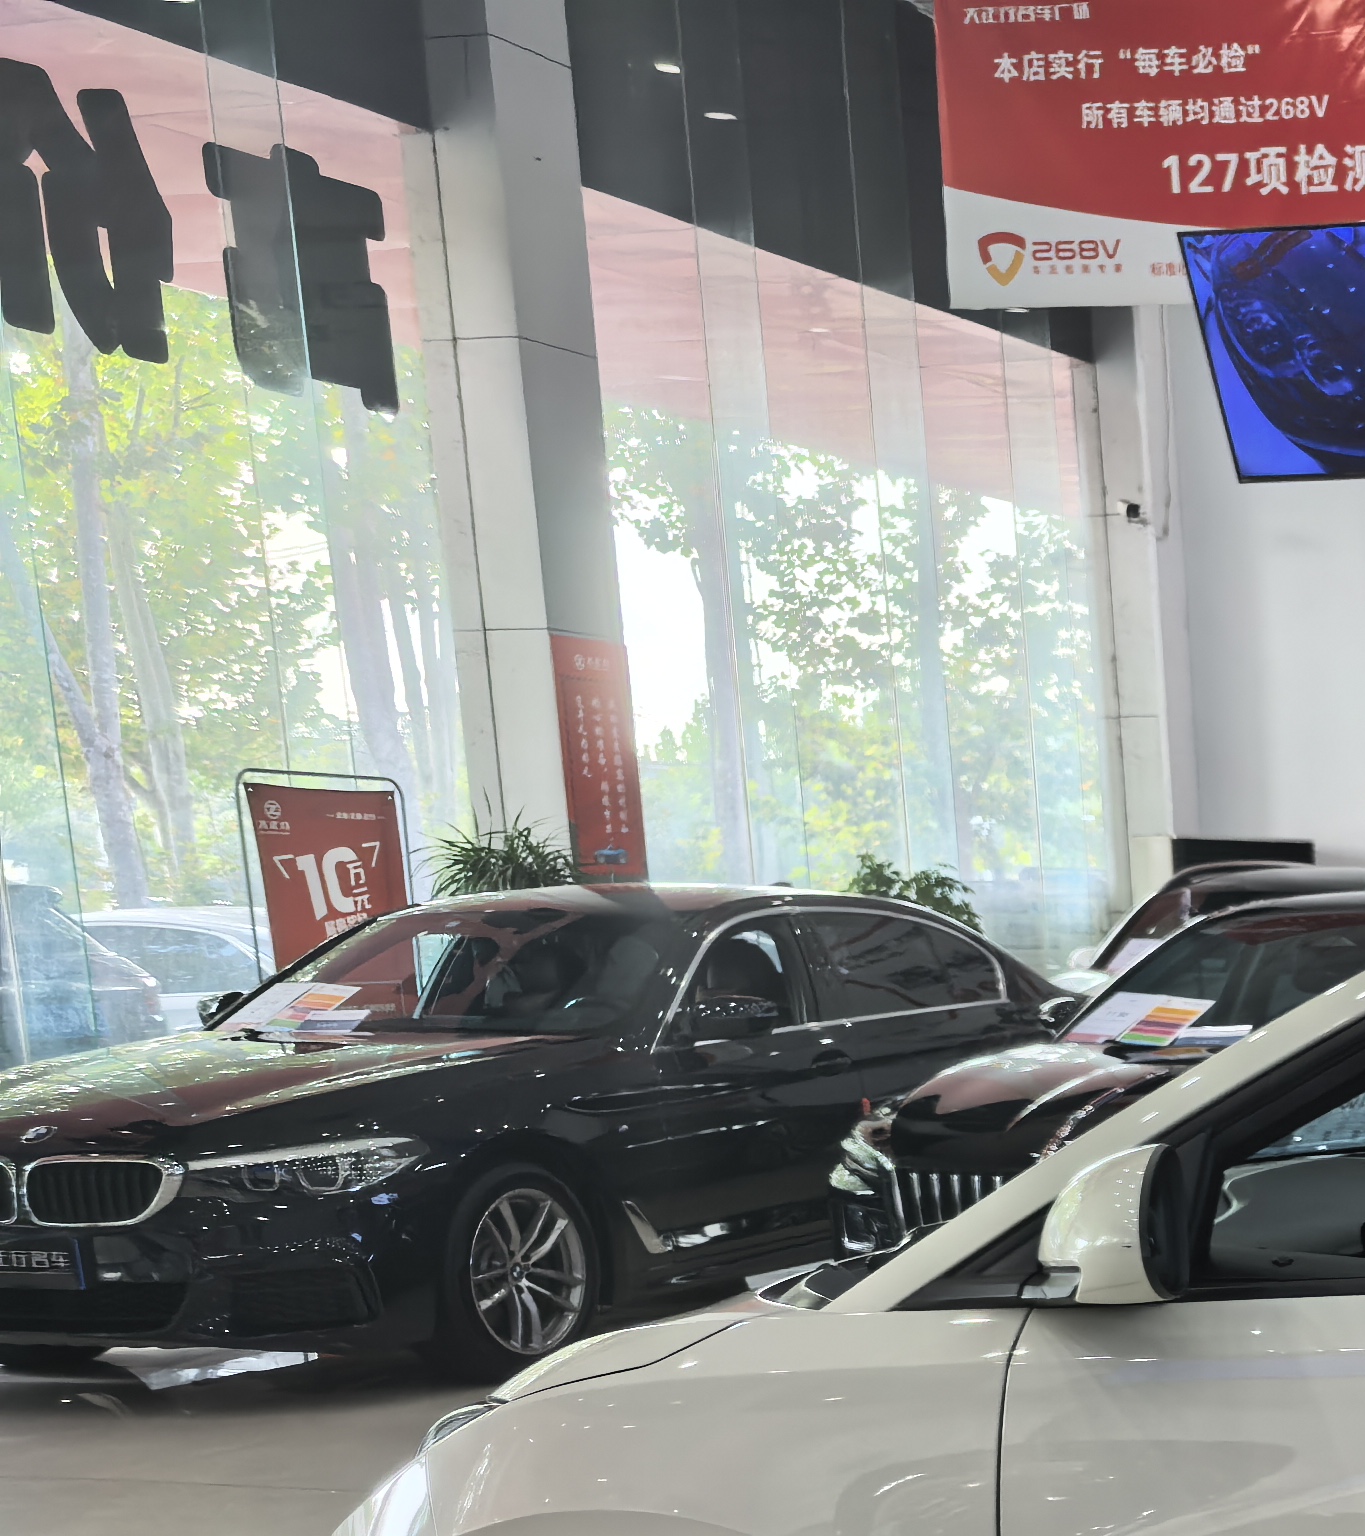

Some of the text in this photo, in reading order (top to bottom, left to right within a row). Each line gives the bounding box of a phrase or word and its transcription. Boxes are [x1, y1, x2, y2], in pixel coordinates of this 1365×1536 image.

[1081, 95, 1330, 129] 所有车辆均通过268V
[1032, 239, 1121, 261] 268V
